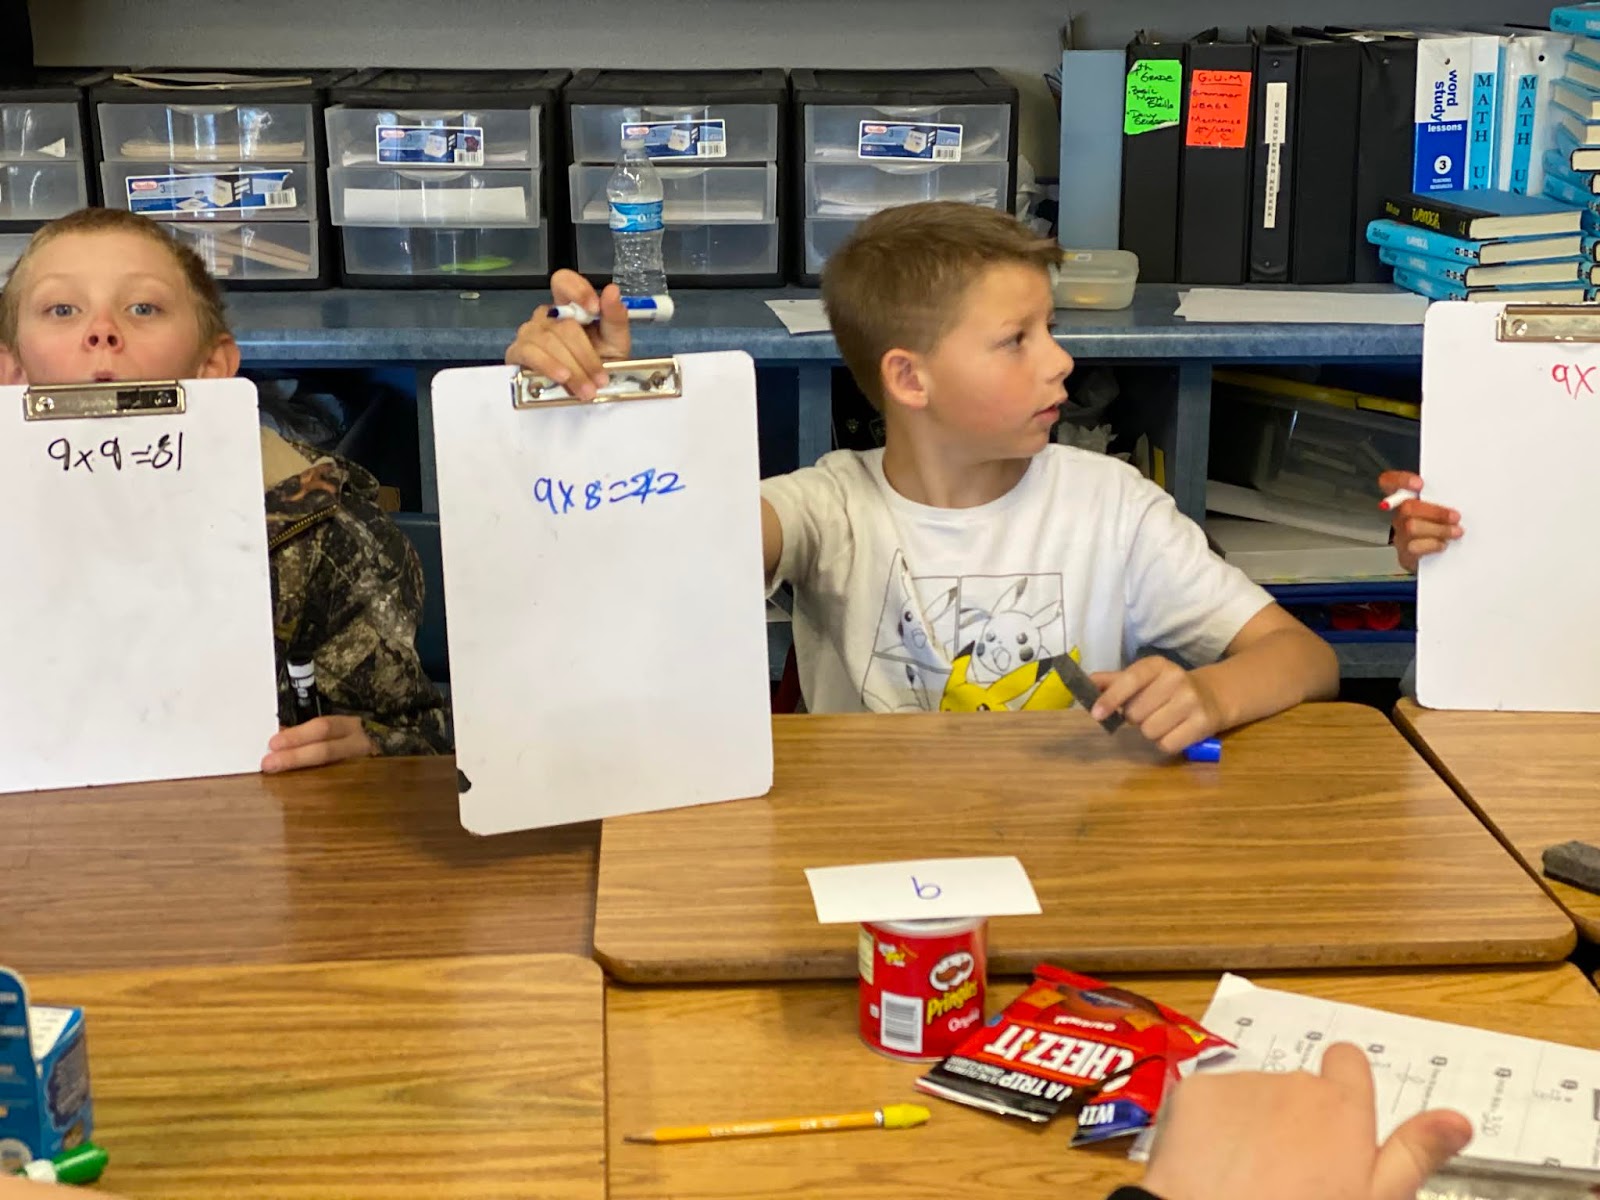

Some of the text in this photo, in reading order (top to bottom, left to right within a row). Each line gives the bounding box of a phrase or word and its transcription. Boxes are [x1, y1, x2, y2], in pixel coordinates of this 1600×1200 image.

[1430, 81, 1446, 122] study
[1446, 69, 1459, 107] word
[1475, 74, 1493, 143] MATH
[1428, 123, 1463, 133] lessons
[1517, 76, 1537, 145] MATH
[1439, 160, 1447, 170] 3
[926, 981, 978, 1026] Pringles
